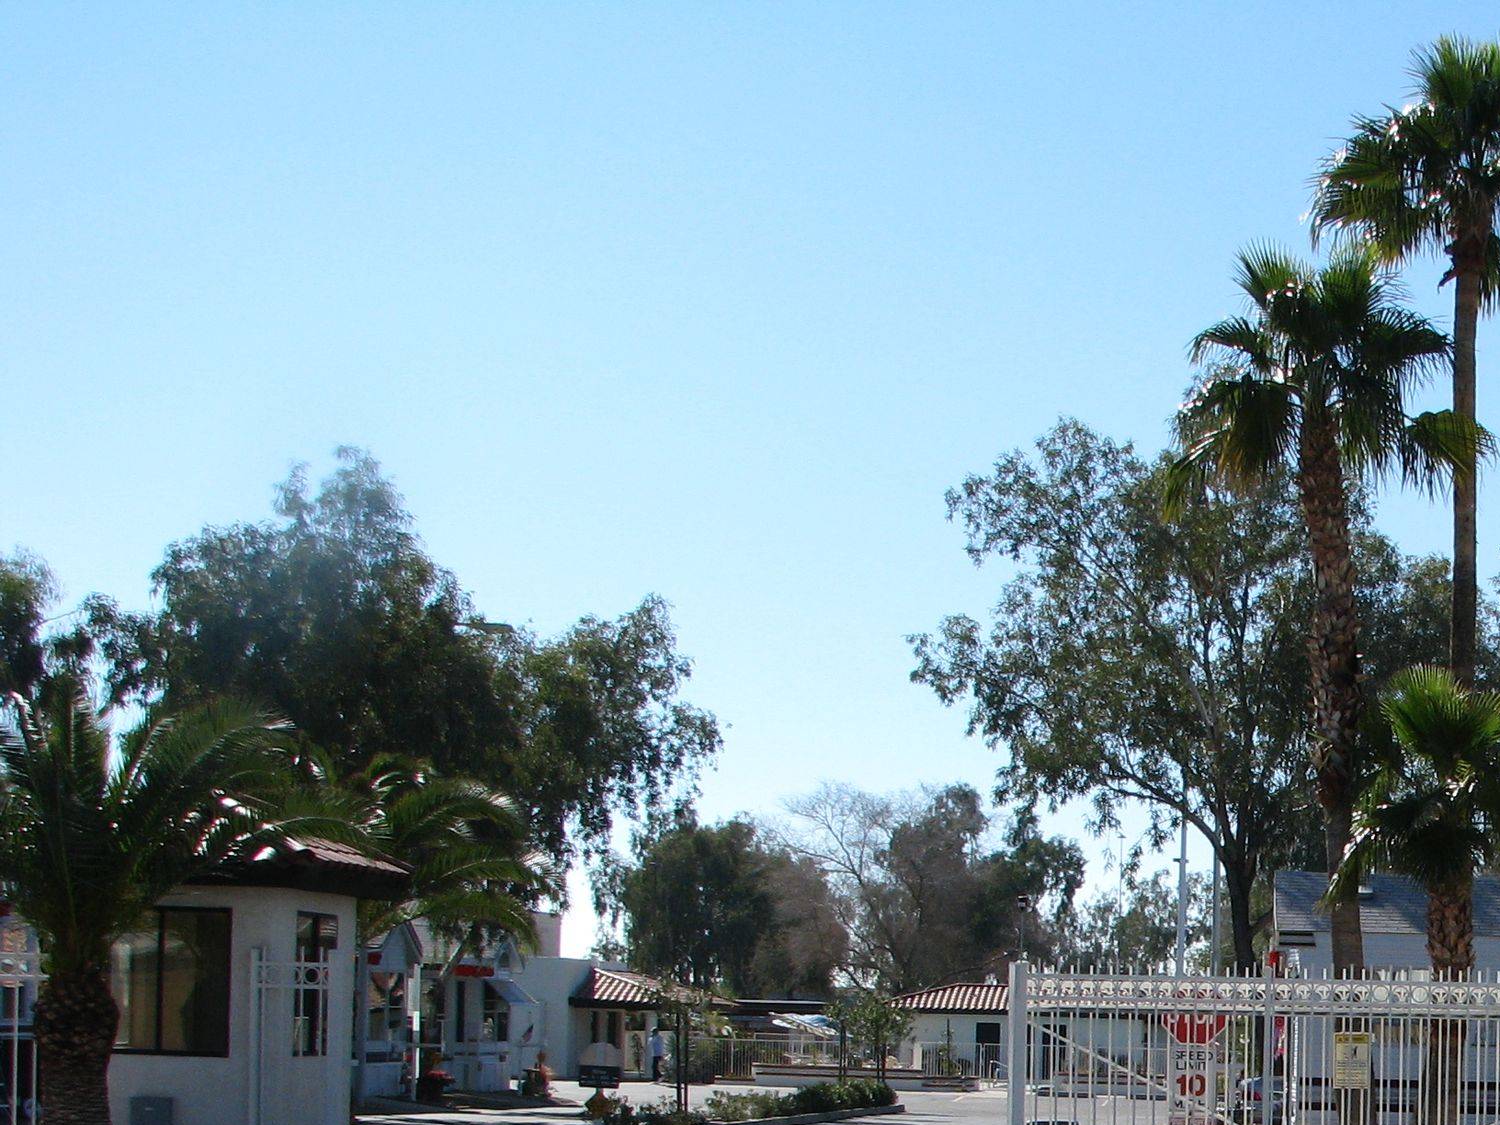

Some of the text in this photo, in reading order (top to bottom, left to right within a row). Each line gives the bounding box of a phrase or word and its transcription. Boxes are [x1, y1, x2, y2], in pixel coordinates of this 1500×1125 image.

[1175, 1050, 1214, 1061] SPEED
[1175, 1061, 1207, 1071] LIMIT
[1176, 1074, 1206, 1096] 10
